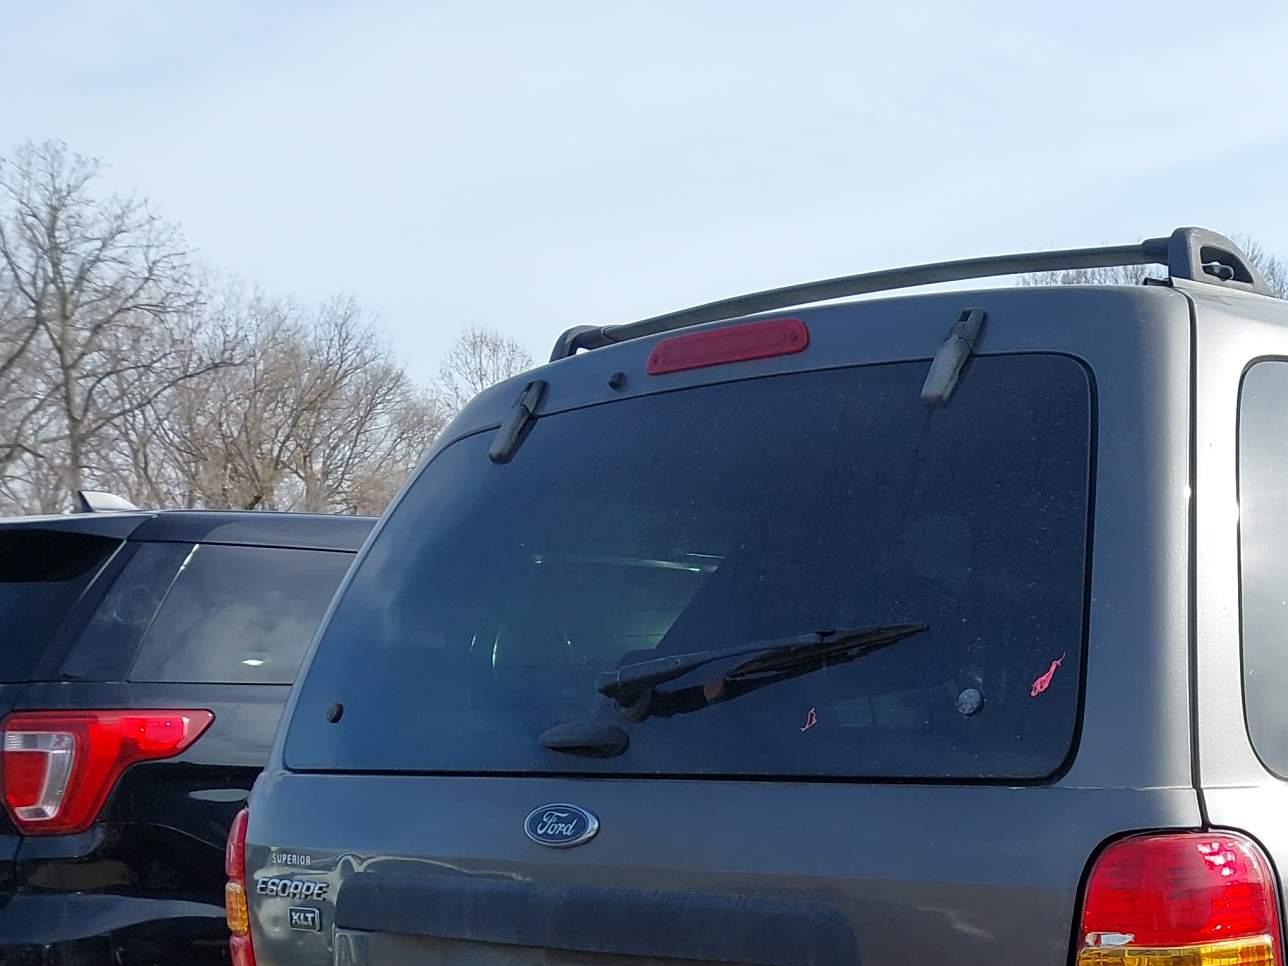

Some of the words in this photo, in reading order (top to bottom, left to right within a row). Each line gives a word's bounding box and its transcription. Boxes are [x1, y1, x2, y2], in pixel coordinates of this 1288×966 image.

[537, 811, 577, 836] Ford
[272, 853, 311, 865] SUPERIOR
[256, 877, 329, 901] ESCAPE
[291, 911, 315, 926] XLT
